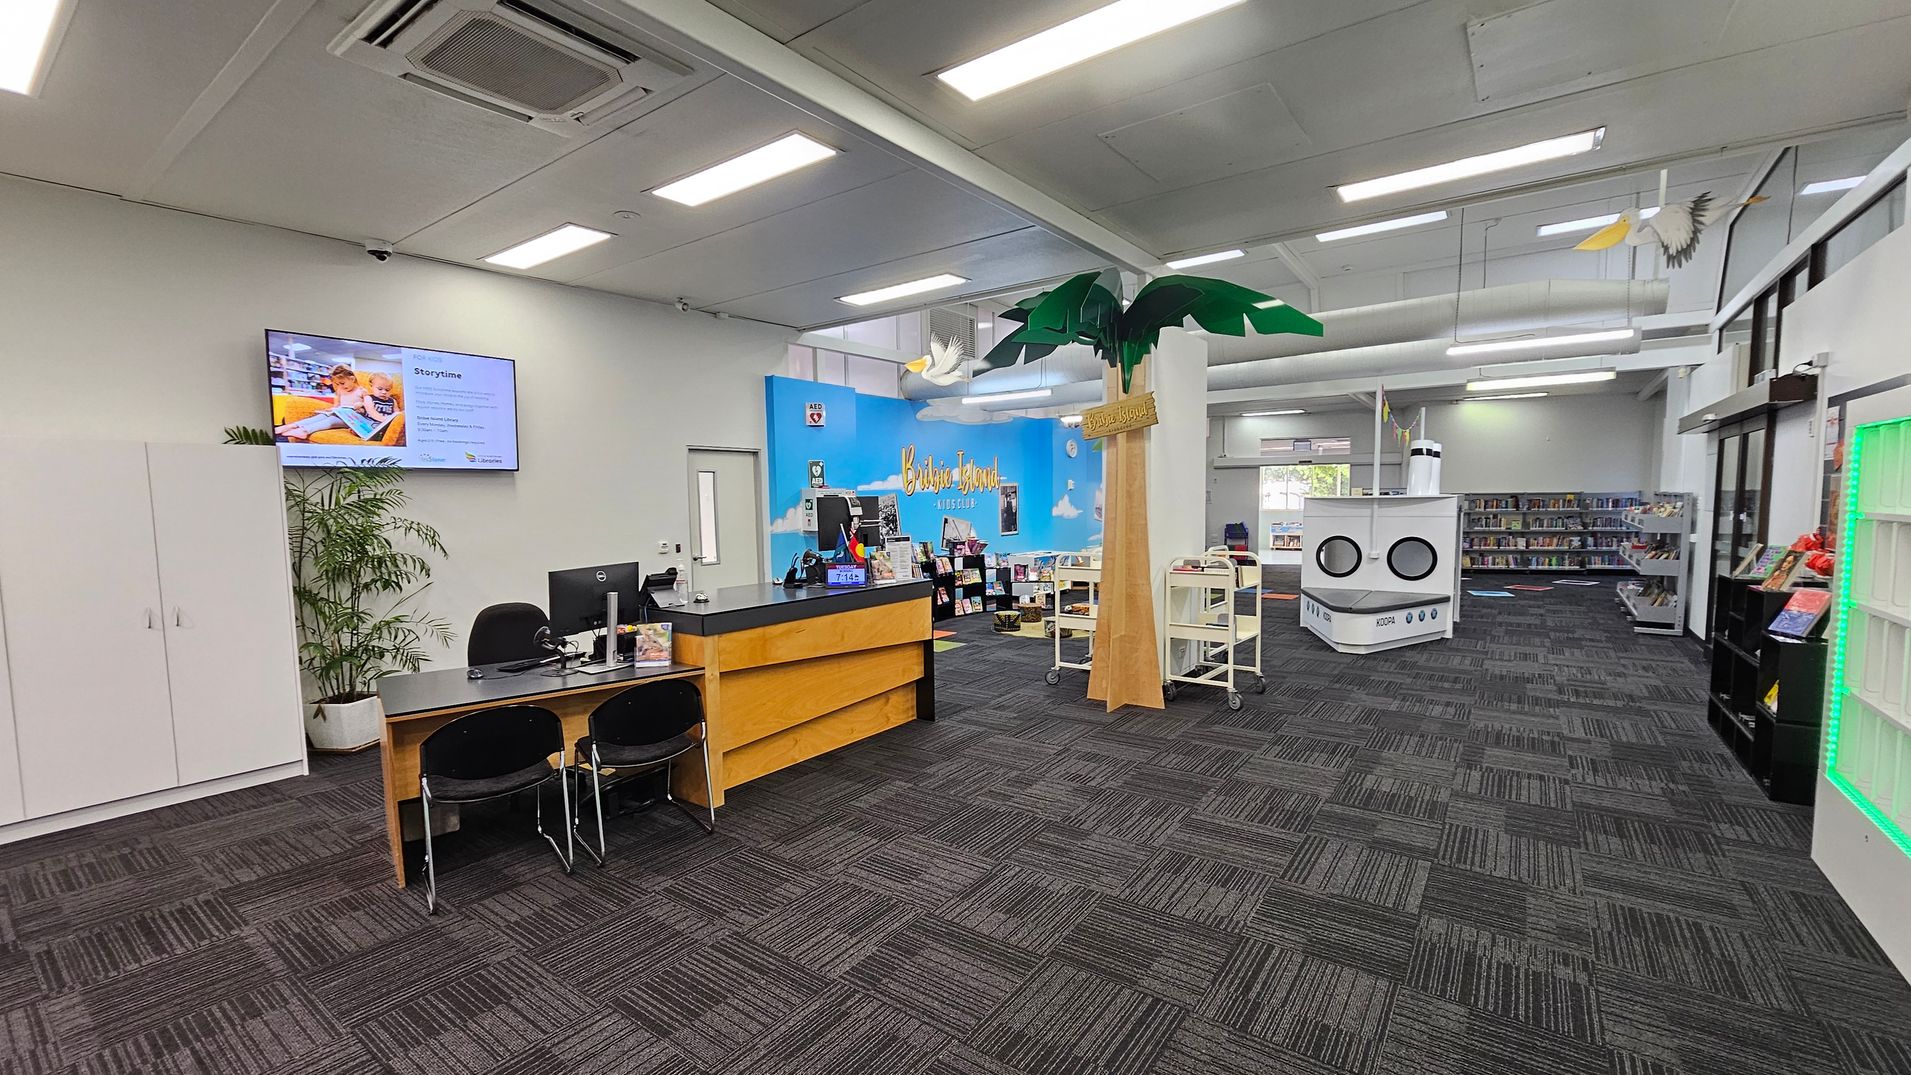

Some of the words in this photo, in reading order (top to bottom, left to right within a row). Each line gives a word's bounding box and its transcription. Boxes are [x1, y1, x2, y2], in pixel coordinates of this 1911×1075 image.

[414, 367, 462, 379] Storytime
[901, 444, 953, 496] Bribie
[956, 449, 1000, 495] Island
[1376, 616, 1396, 627] KOOPA
